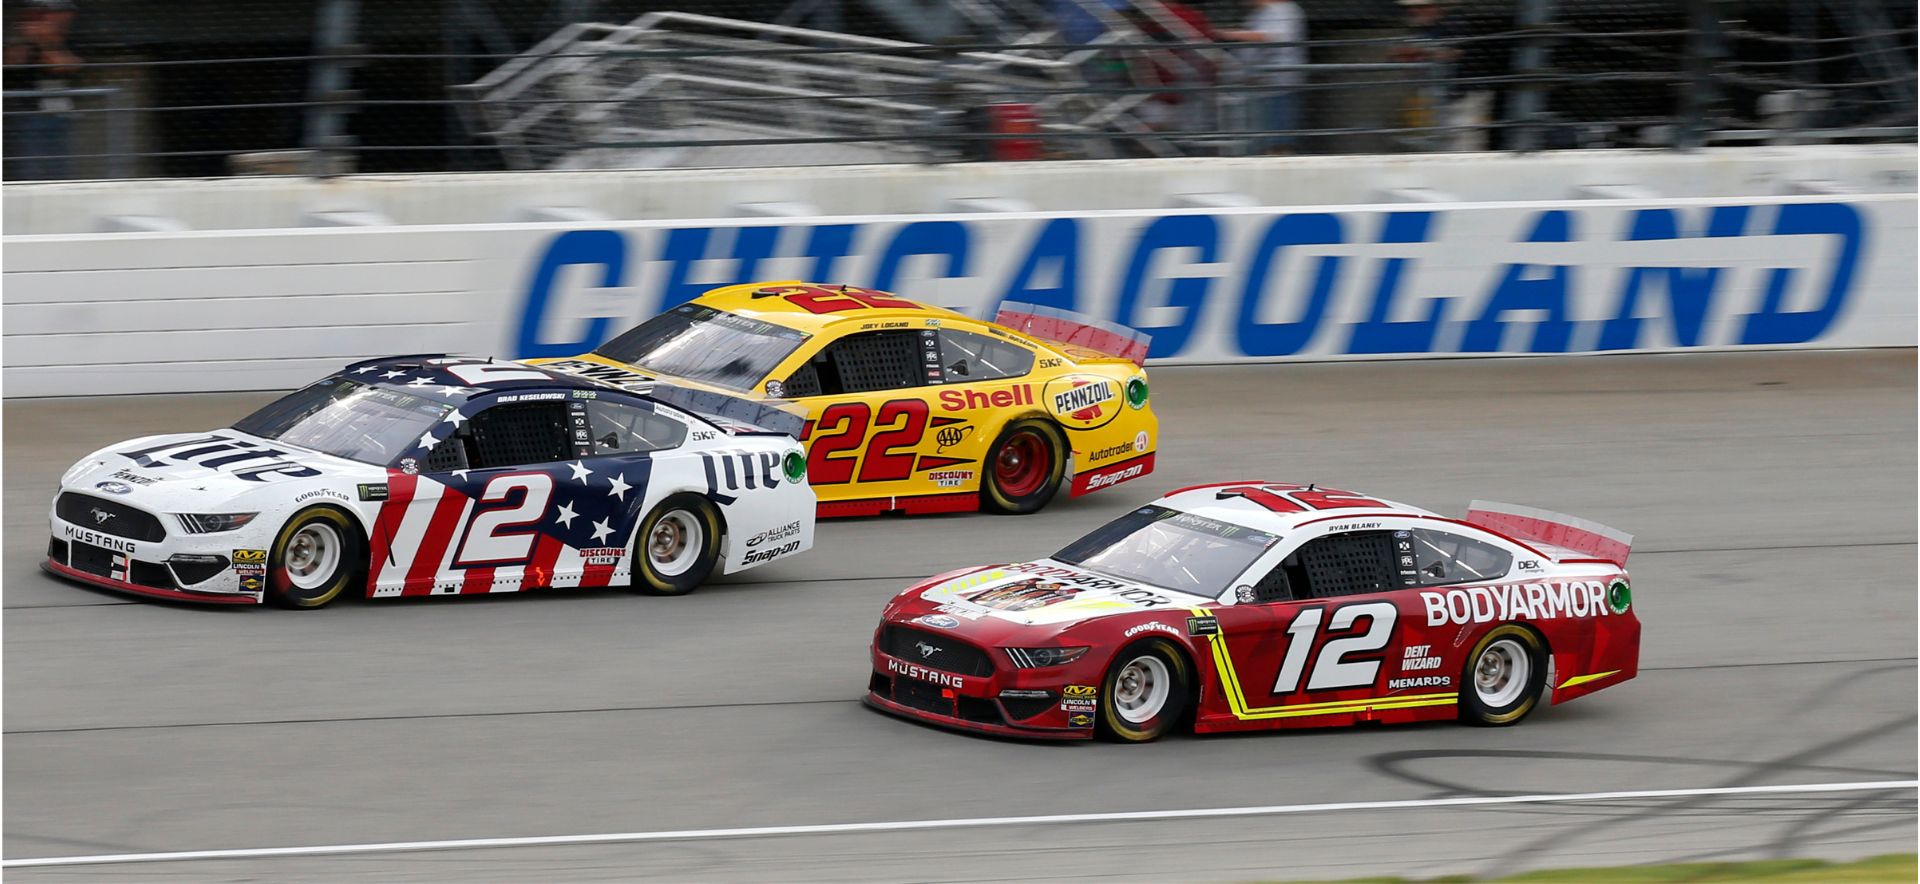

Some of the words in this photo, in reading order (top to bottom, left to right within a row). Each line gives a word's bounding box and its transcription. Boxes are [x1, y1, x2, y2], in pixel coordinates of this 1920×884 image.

[758, 285, 926, 315] 22
[425, 357, 558, 387] 2
[1039, 359, 1063, 369] SKF
[497, 395, 518, 403] BRAD
[519, 393, 566, 401] KESELOWSKI
[939, 383, 1033, 412] Shell
[1055, 381, 1113, 414] PENNZOIL
[692, 431, 717, 441] SKF
[806, 398, 929, 486] 22
[938, 427, 962, 446] AAA
[1089, 442, 1134, 462] Autotrader
[692, 448, 781, 506] Lite
[929, 471, 973, 481] DISCOUNT
[1086, 464, 1143, 490] Snap-on
[295, 488, 350, 503] GOODYEAR
[1221, 486, 1392, 512] 12
[456, 472, 554, 565] 2
[1329, 524, 1350, 532] RYAN
[767, 521, 800, 536] ALLIANCE
[767, 534, 783, 542] TRUCK
[784, 528, 800, 538] PARTS
[65, 525, 136, 553] MUSTANG
[579, 548, 626, 558] DISCOUNT
[741, 540, 800, 566] Snap-on
[1518, 560, 1540, 570] DEX
[1420, 581, 1608, 627] BODYARMOR
[1124, 621, 1180, 638] GOODYEAR
[1272, 601, 1398, 695] 12
[1404, 645, 1431, 659] DENT
[888, 659, 963, 688] MUSTANG
[1402, 657, 1441, 671] WIZARD
[1389, 676, 1450, 689] MENARDS
